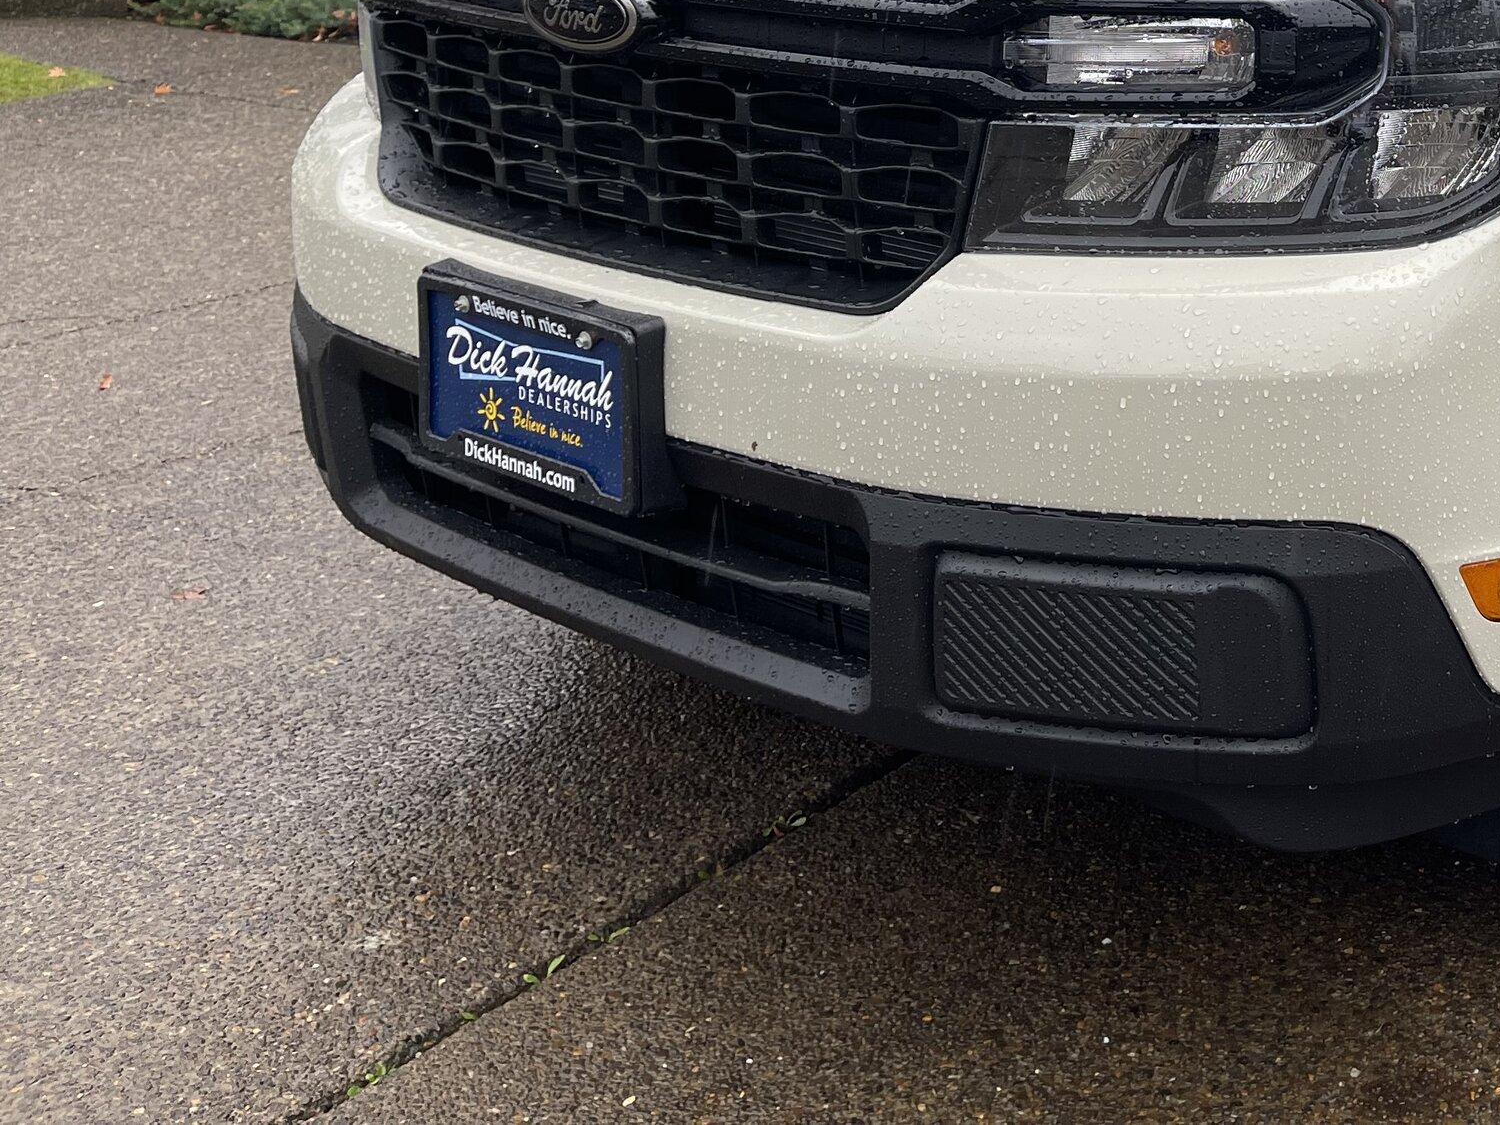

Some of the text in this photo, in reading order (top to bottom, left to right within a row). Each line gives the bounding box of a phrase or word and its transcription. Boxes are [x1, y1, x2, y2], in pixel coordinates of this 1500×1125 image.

[472, 295, 572, 340] Believe in nice.
[446, 325, 614, 411] Dick Hannah
[510, 406, 583, 448] Believe in nice.
[518, 386, 611, 429] DEALERSHIPS
[464, 437, 575, 493] DickHannah.com
